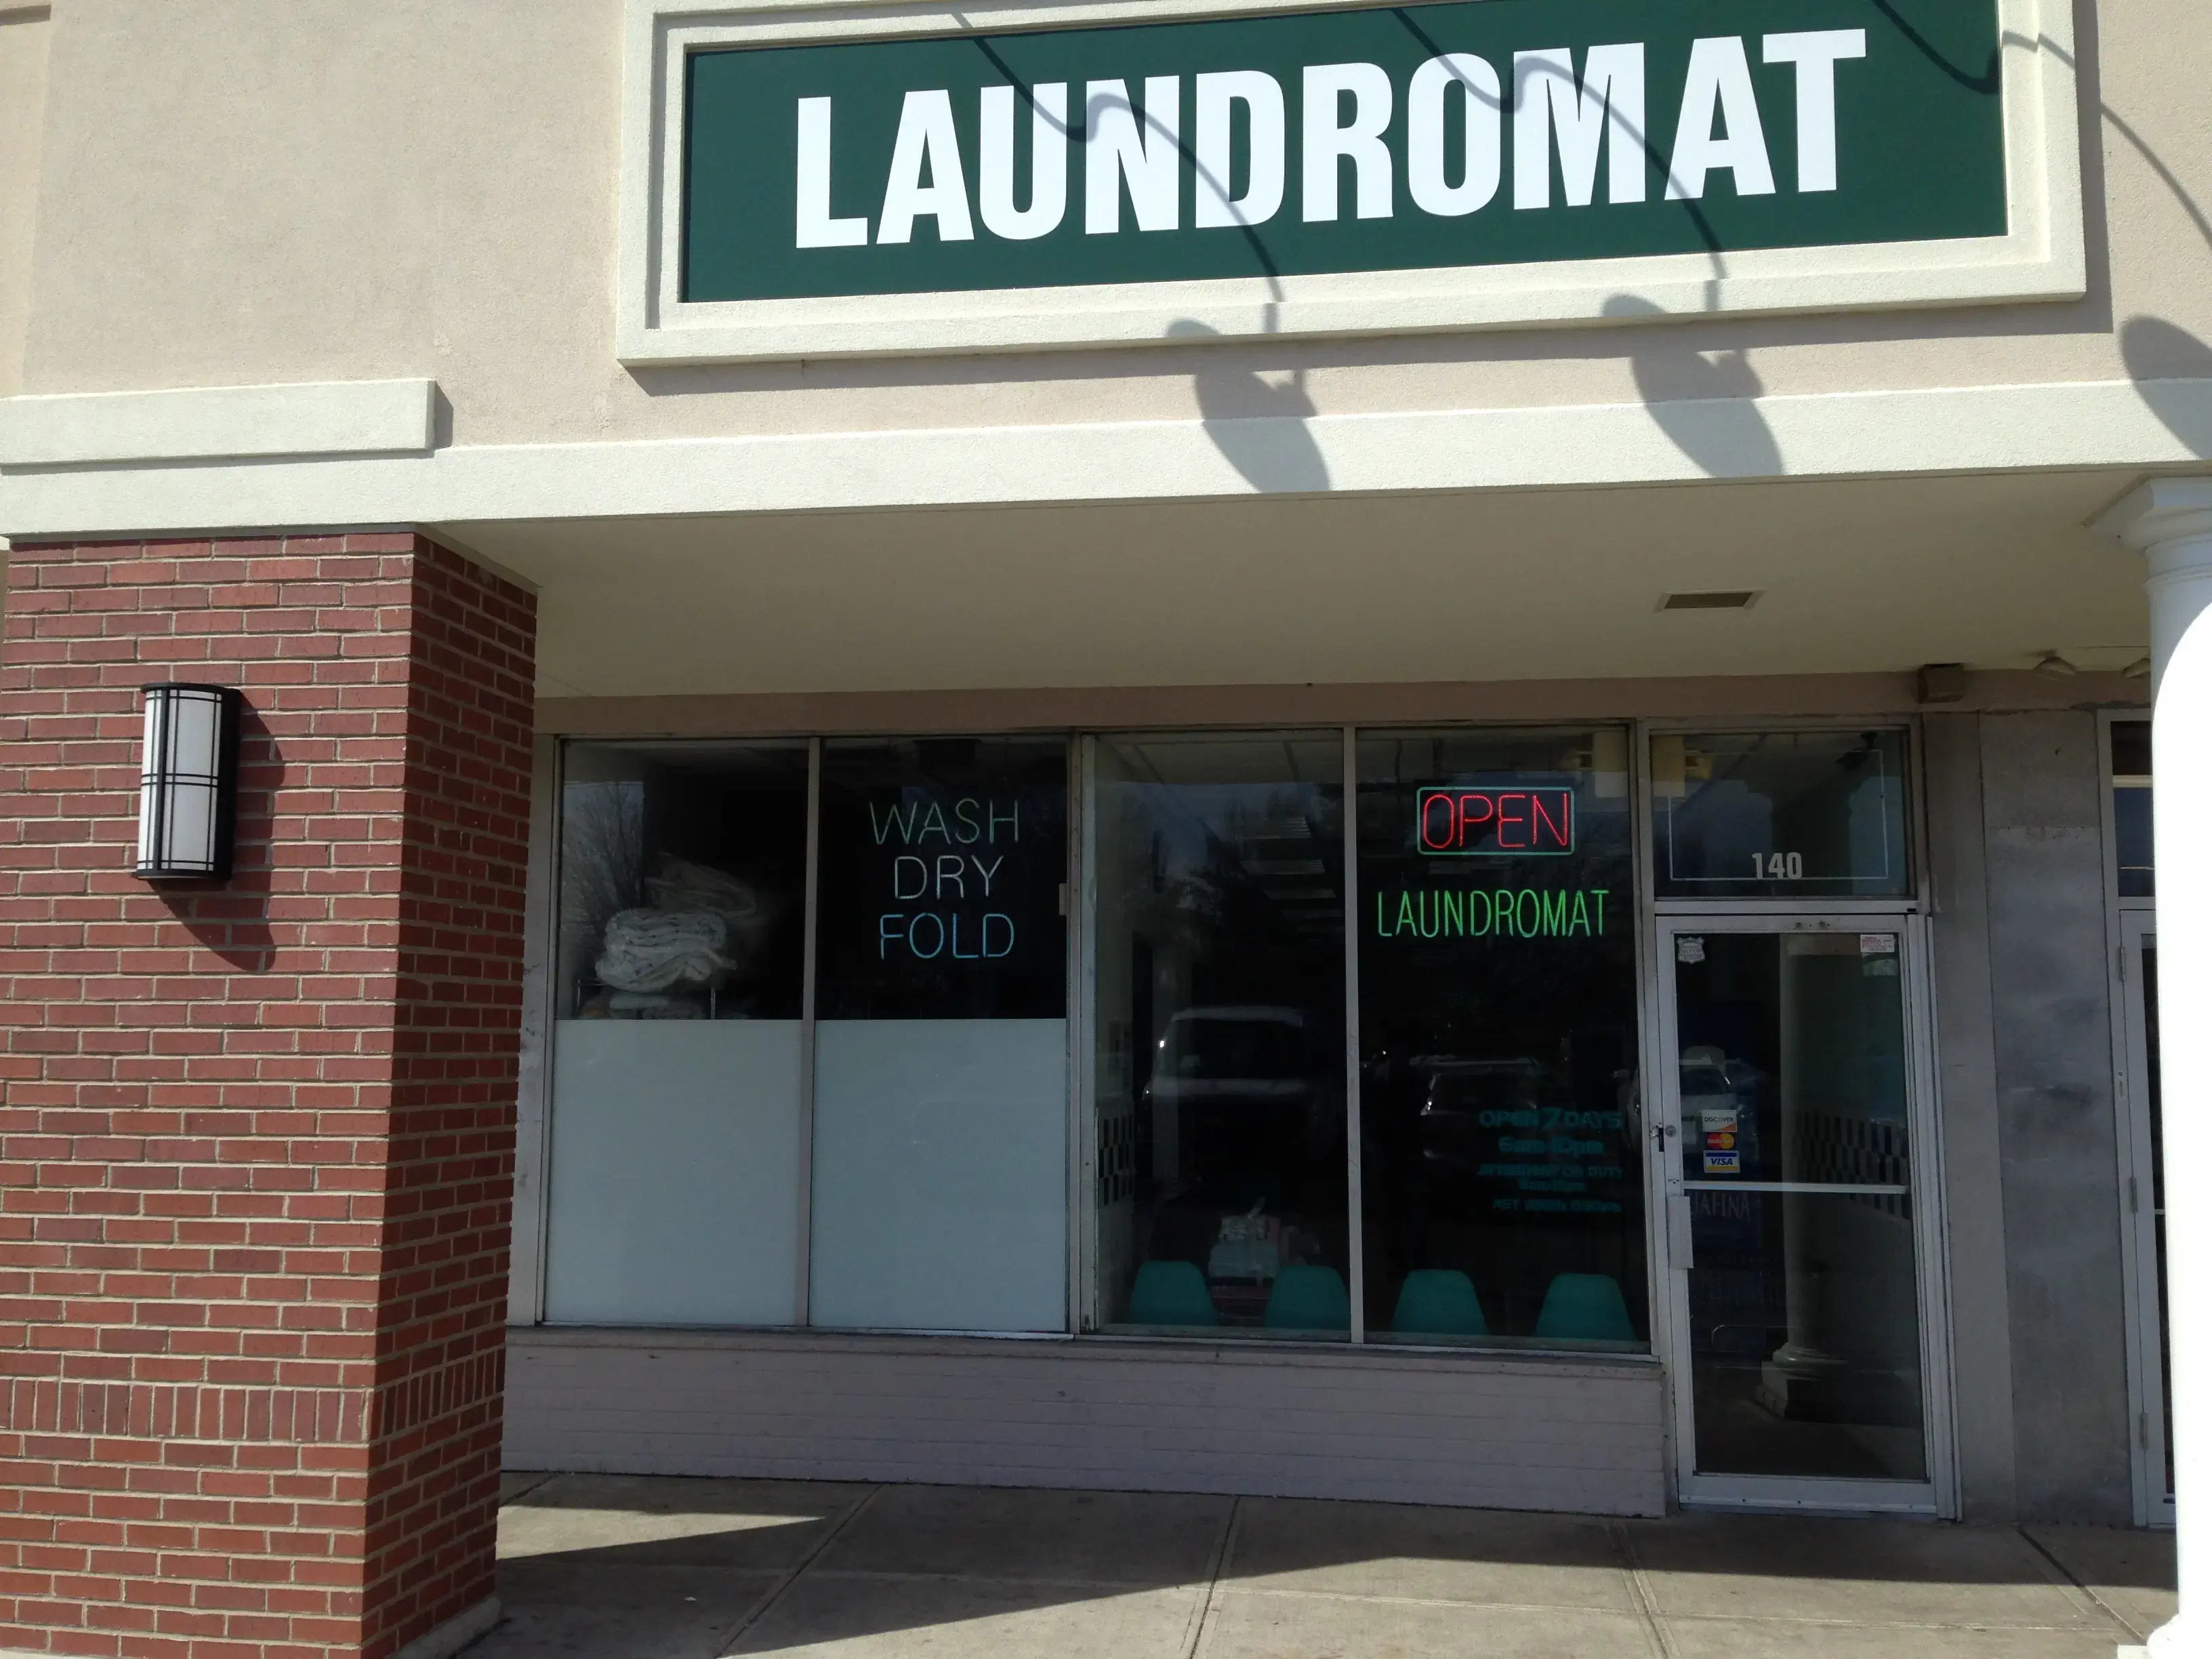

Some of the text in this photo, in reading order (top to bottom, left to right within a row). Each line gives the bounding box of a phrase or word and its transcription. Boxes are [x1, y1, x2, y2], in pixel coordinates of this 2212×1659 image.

[796, 28, 1866, 249] LAUNDROMAT
[869, 798, 1019, 845] WASH
[1422, 792, 1569, 849] OPEN
[894, 855, 1005, 900] DRY
[1751, 852, 1803, 880] 140
[879, 912, 1015, 960] FOLD
[1376, 888, 1610, 939] LAUNDROMAT
[1541, 1107, 1563, 1132] 7
[1564, 1110, 1622, 1130] DAYS
[1711, 1158, 1734, 1166] VISA
